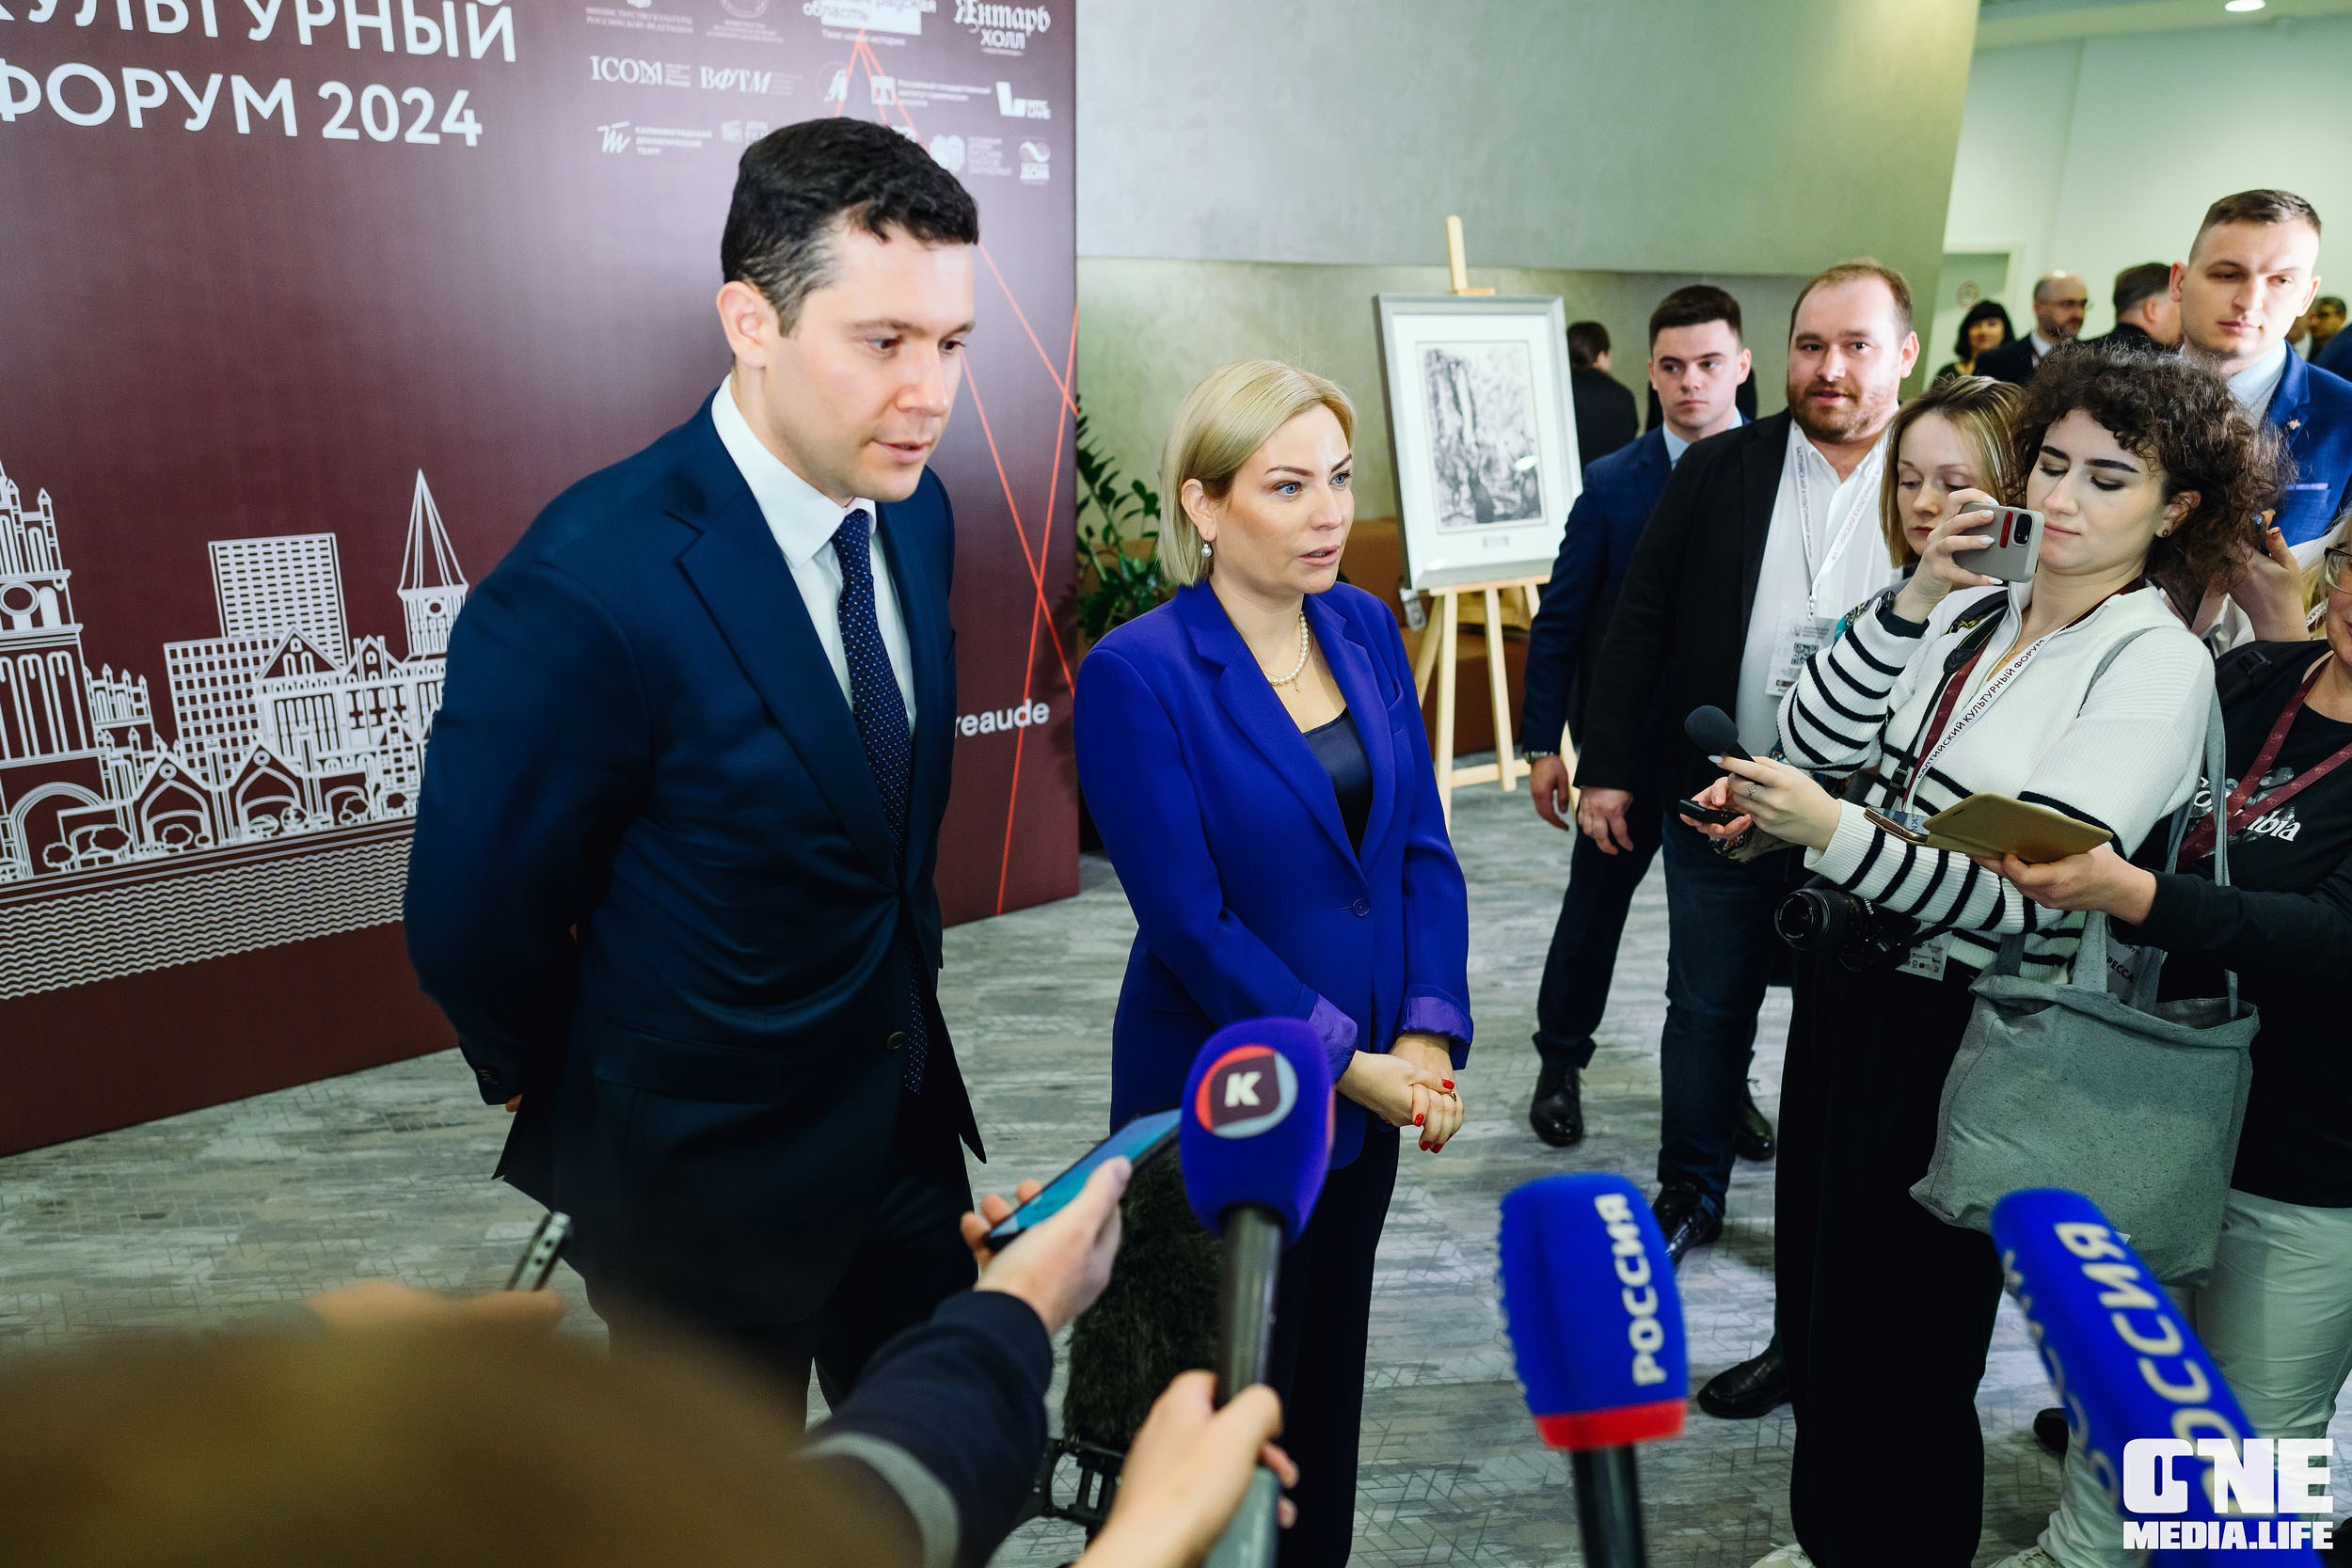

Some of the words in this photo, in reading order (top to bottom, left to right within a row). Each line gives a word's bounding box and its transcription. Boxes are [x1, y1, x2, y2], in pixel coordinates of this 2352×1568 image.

[0, 0, 516, 62] ЛЬТУРНЫЙ
[980, 29, 1025, 50] ХОЛЛ
[590, 55, 662, 86] ICOM
[0, 57, 298, 137] ФОРУМ
[317, 80, 483, 147] 2024
[1917, 721, 1965, 779] БАЛТИЙСКИЙ
[1964, 668, 2016, 723] КУЛЬТУРНЫЙ
[2014, 639, 2045, 669] ФОРУМ
[2107, 955, 2135, 984] РЕССА
[1593, 1192, 1668, 1387] РОССИЯ
